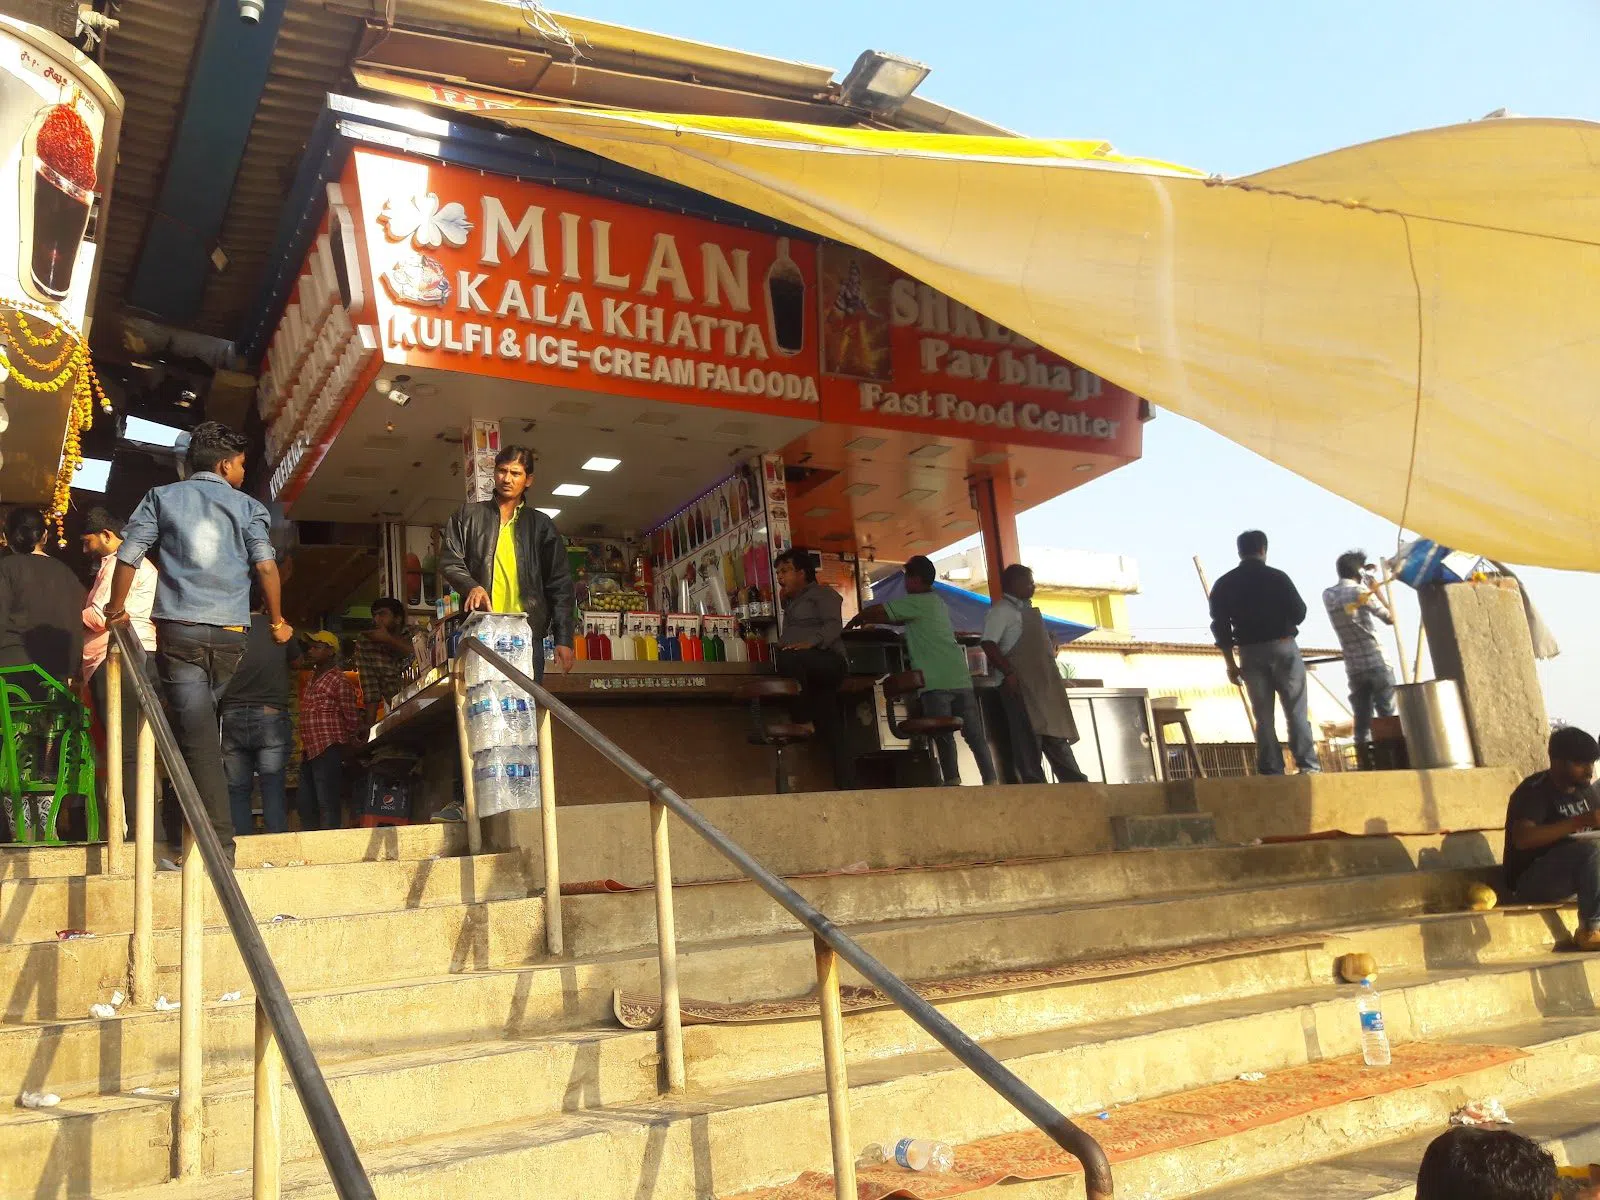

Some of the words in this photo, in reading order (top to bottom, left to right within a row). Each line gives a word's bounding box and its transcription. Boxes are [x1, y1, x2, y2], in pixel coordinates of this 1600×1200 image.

[480, 195, 752, 313] MILAN
[391, 312, 493, 358] KULFI
[499, 327, 521, 359] &
[527, 331, 695, 388] ICE-CREAM
[699, 363, 819, 403] FALOODA
[456, 269, 594, 334] KALA
[601, 297, 768, 361] KHATTA
[859, 382, 933, 417] Fast
[936, 393, 1015, 428] Food
[1022, 403, 1121, 440] Center
